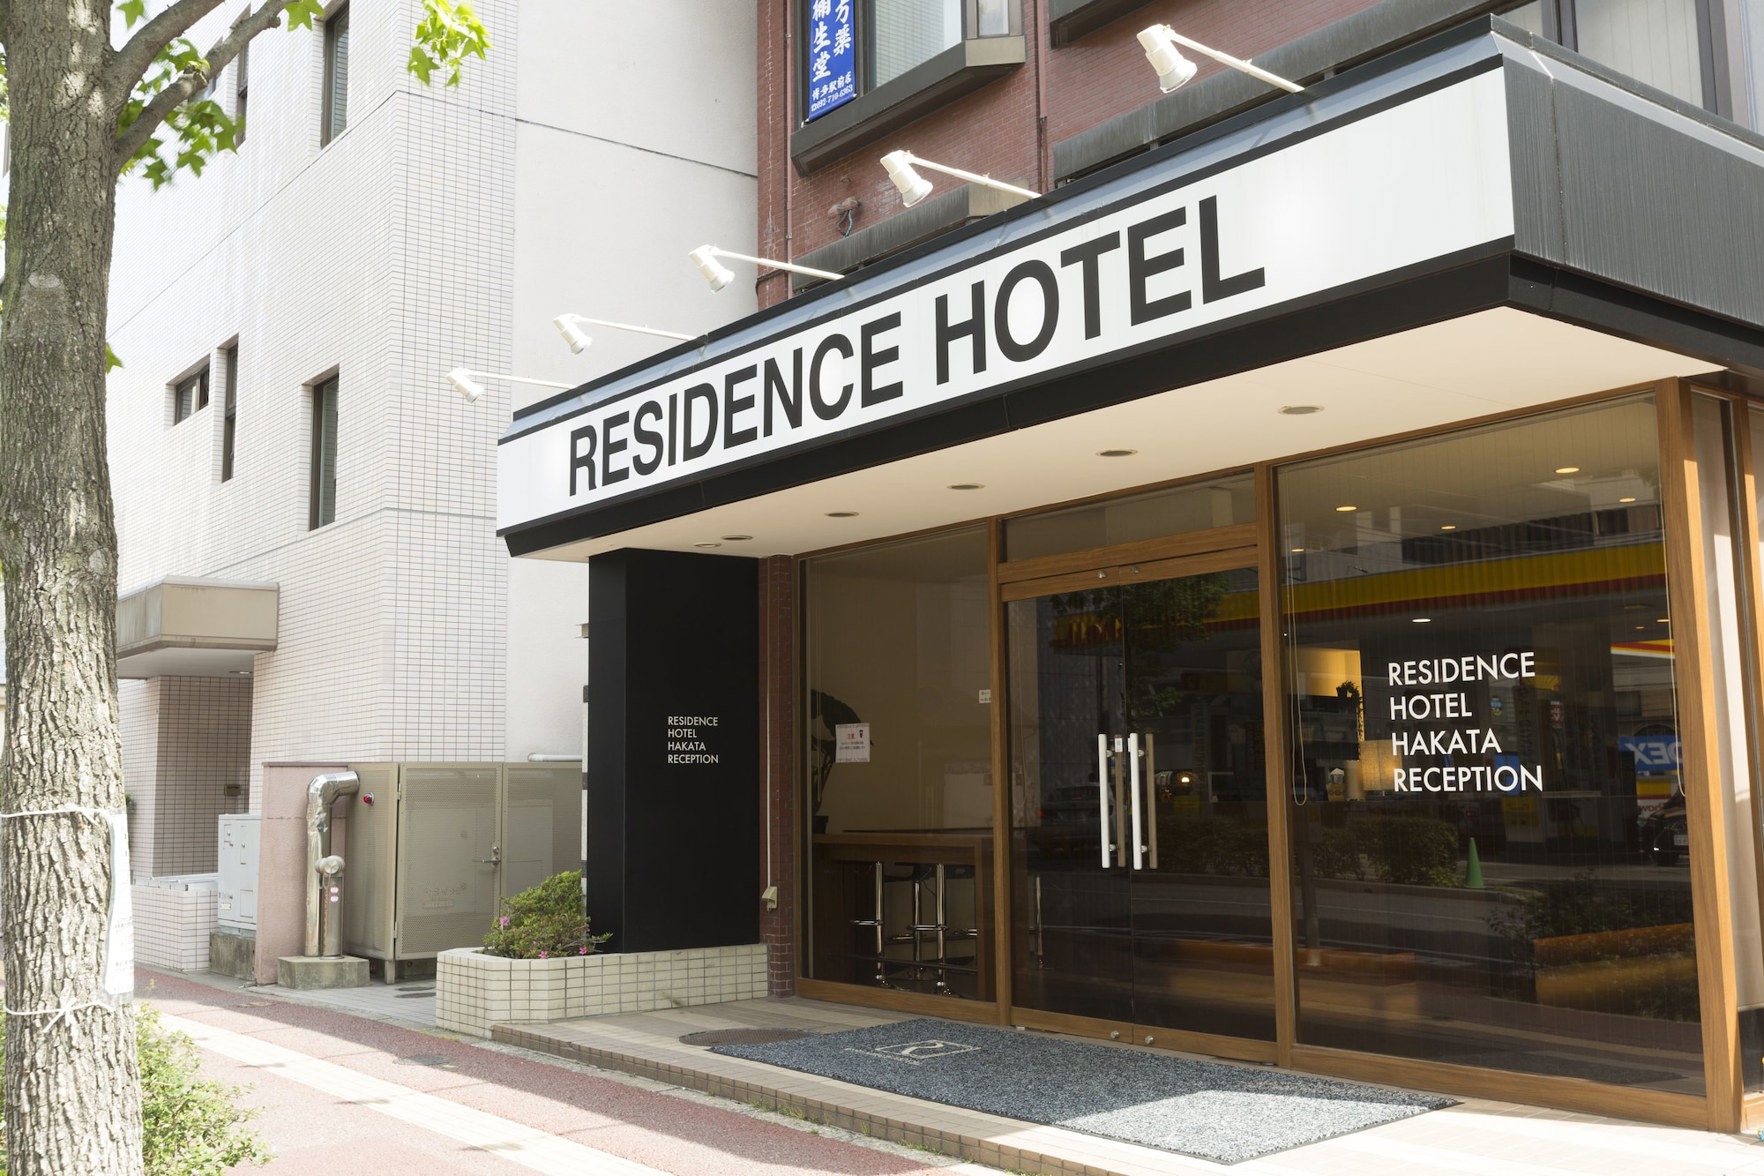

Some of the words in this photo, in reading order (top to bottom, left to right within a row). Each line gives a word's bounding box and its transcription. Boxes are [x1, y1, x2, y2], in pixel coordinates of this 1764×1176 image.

[569, 311, 903, 497] RESIDENCE
[935, 195, 1266, 385] HOTEL
[1388, 651, 1536, 686] RESIDENCE
[1390, 692, 1472, 721] HOTEL
[667, 715, 719, 726] RESIDENCE
[667, 728, 698, 738] HOTEL
[667, 741, 707, 751] HAKATA
[1392, 728, 1502, 756] HAKATA
[667, 754, 719, 764] RECEPTION
[1394, 765, 1543, 792] RECEPTION
